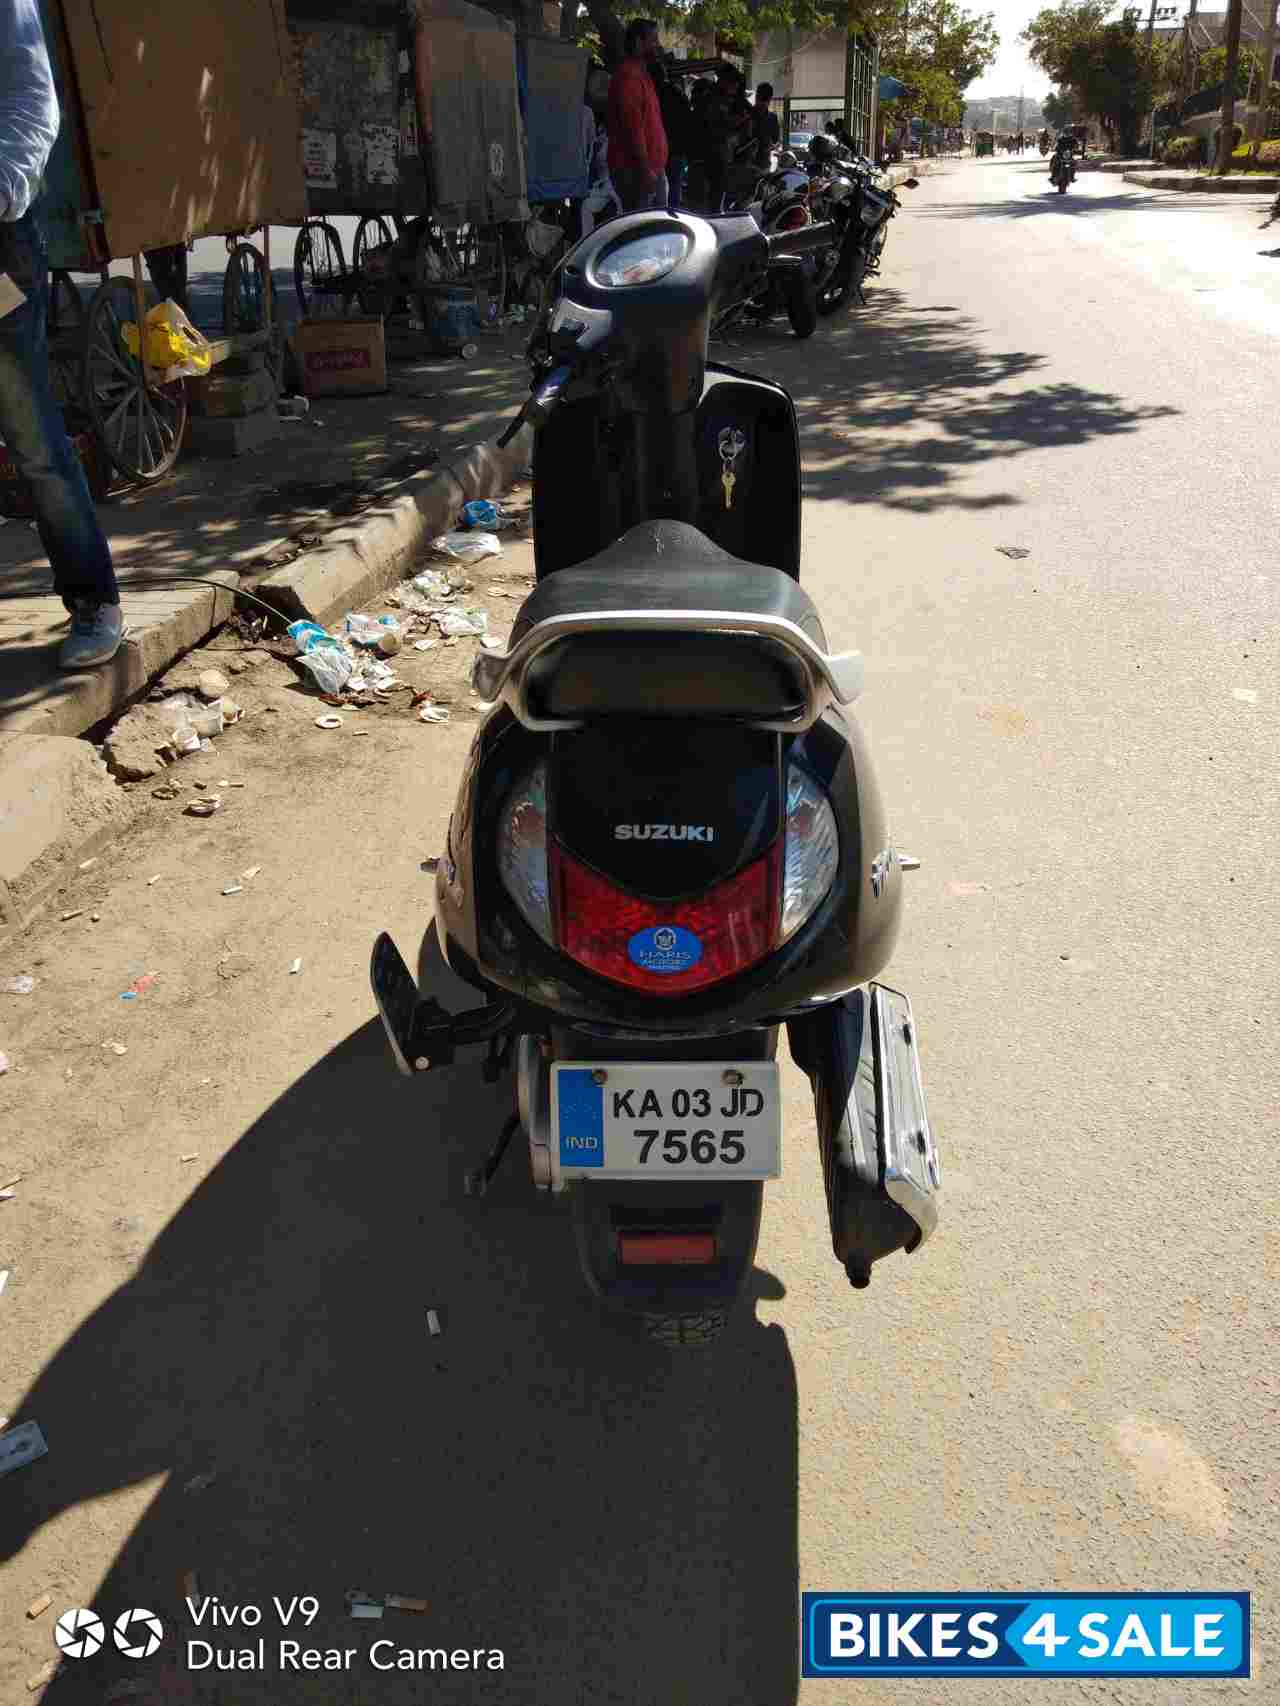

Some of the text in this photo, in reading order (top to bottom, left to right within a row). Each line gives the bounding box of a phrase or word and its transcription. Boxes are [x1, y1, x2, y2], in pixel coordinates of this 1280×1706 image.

[614, 824, 714, 842] SUZUKI
[612, 1087, 765, 1119] KA 03 JD
[565, 1136, 598, 1150] IND
[633, 1129, 746, 1165] 7565
